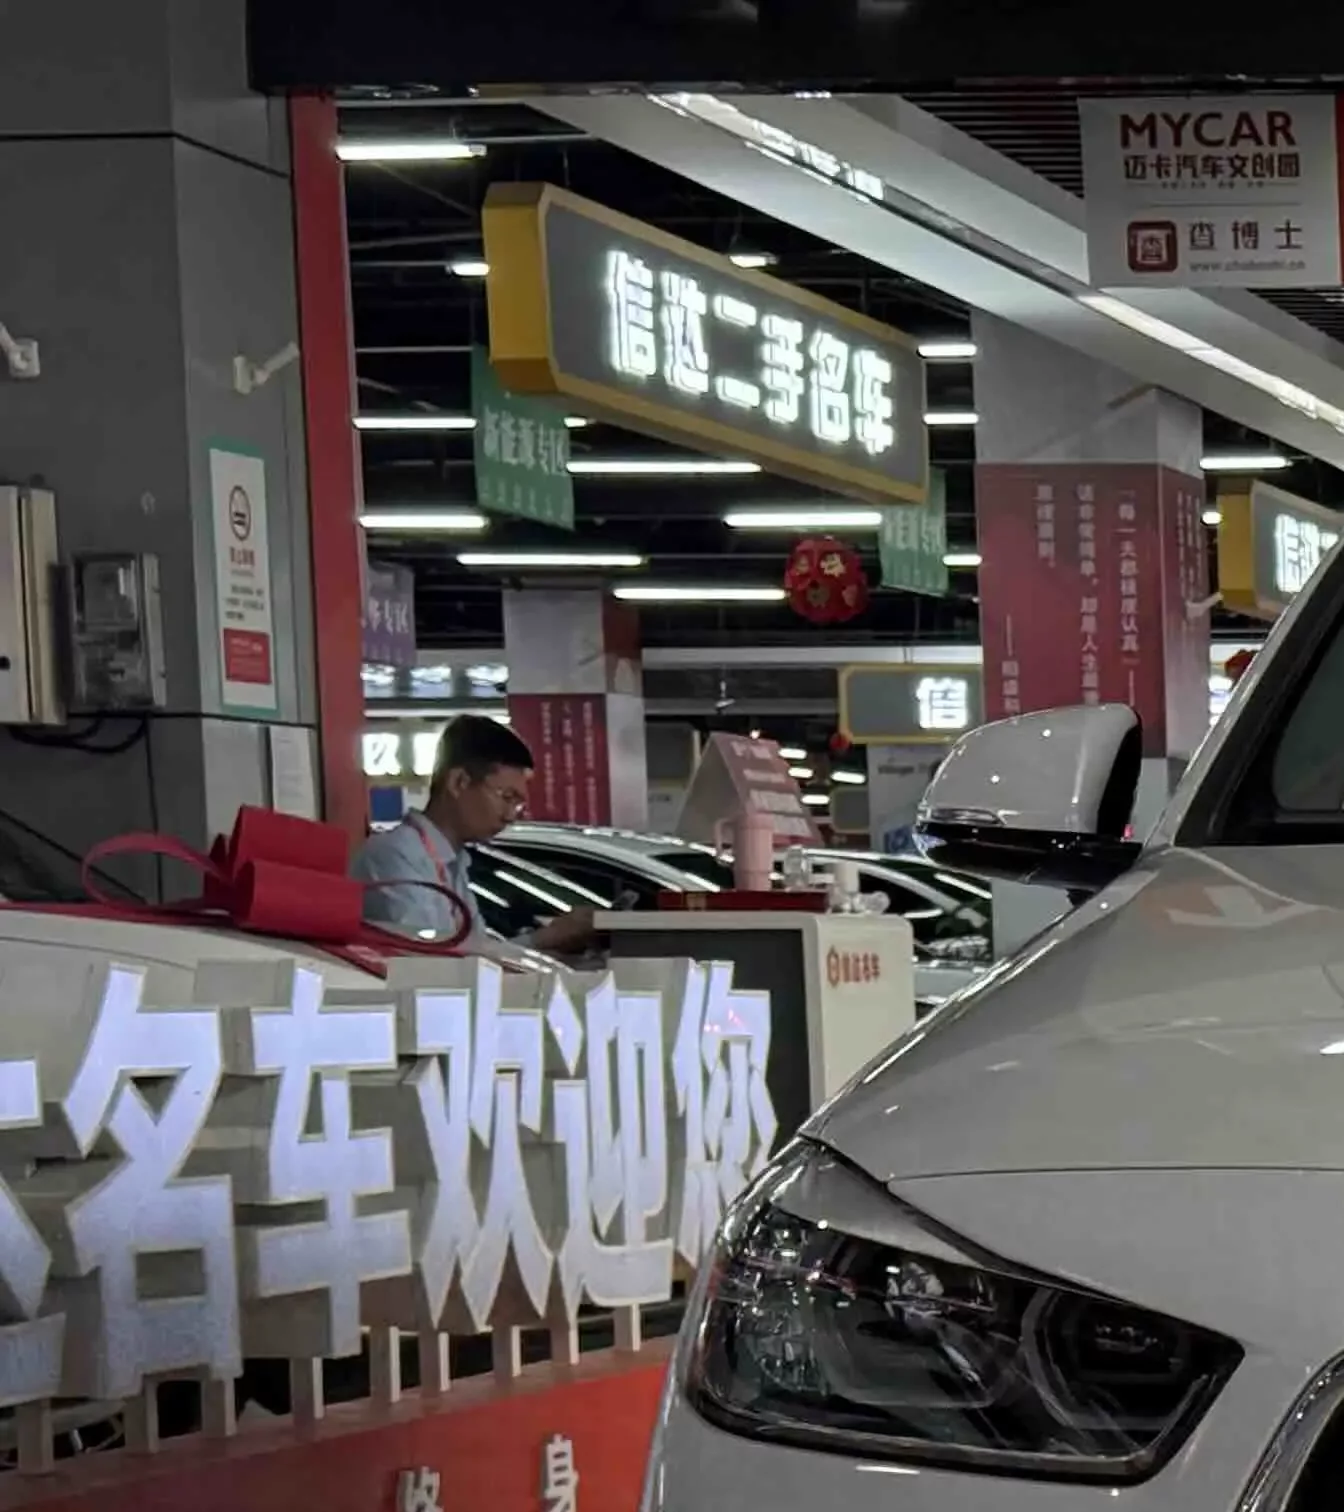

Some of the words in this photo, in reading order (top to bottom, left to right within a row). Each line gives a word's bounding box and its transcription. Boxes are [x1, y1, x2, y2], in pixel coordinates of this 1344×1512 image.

[1119, 110, 1297, 150] MYCAR
[1124, 152, 1300, 181] 迈卡汽车文创园
[1188, 219, 1303, 251] 查博士
[604, 250, 896, 455] 信达二手名车
